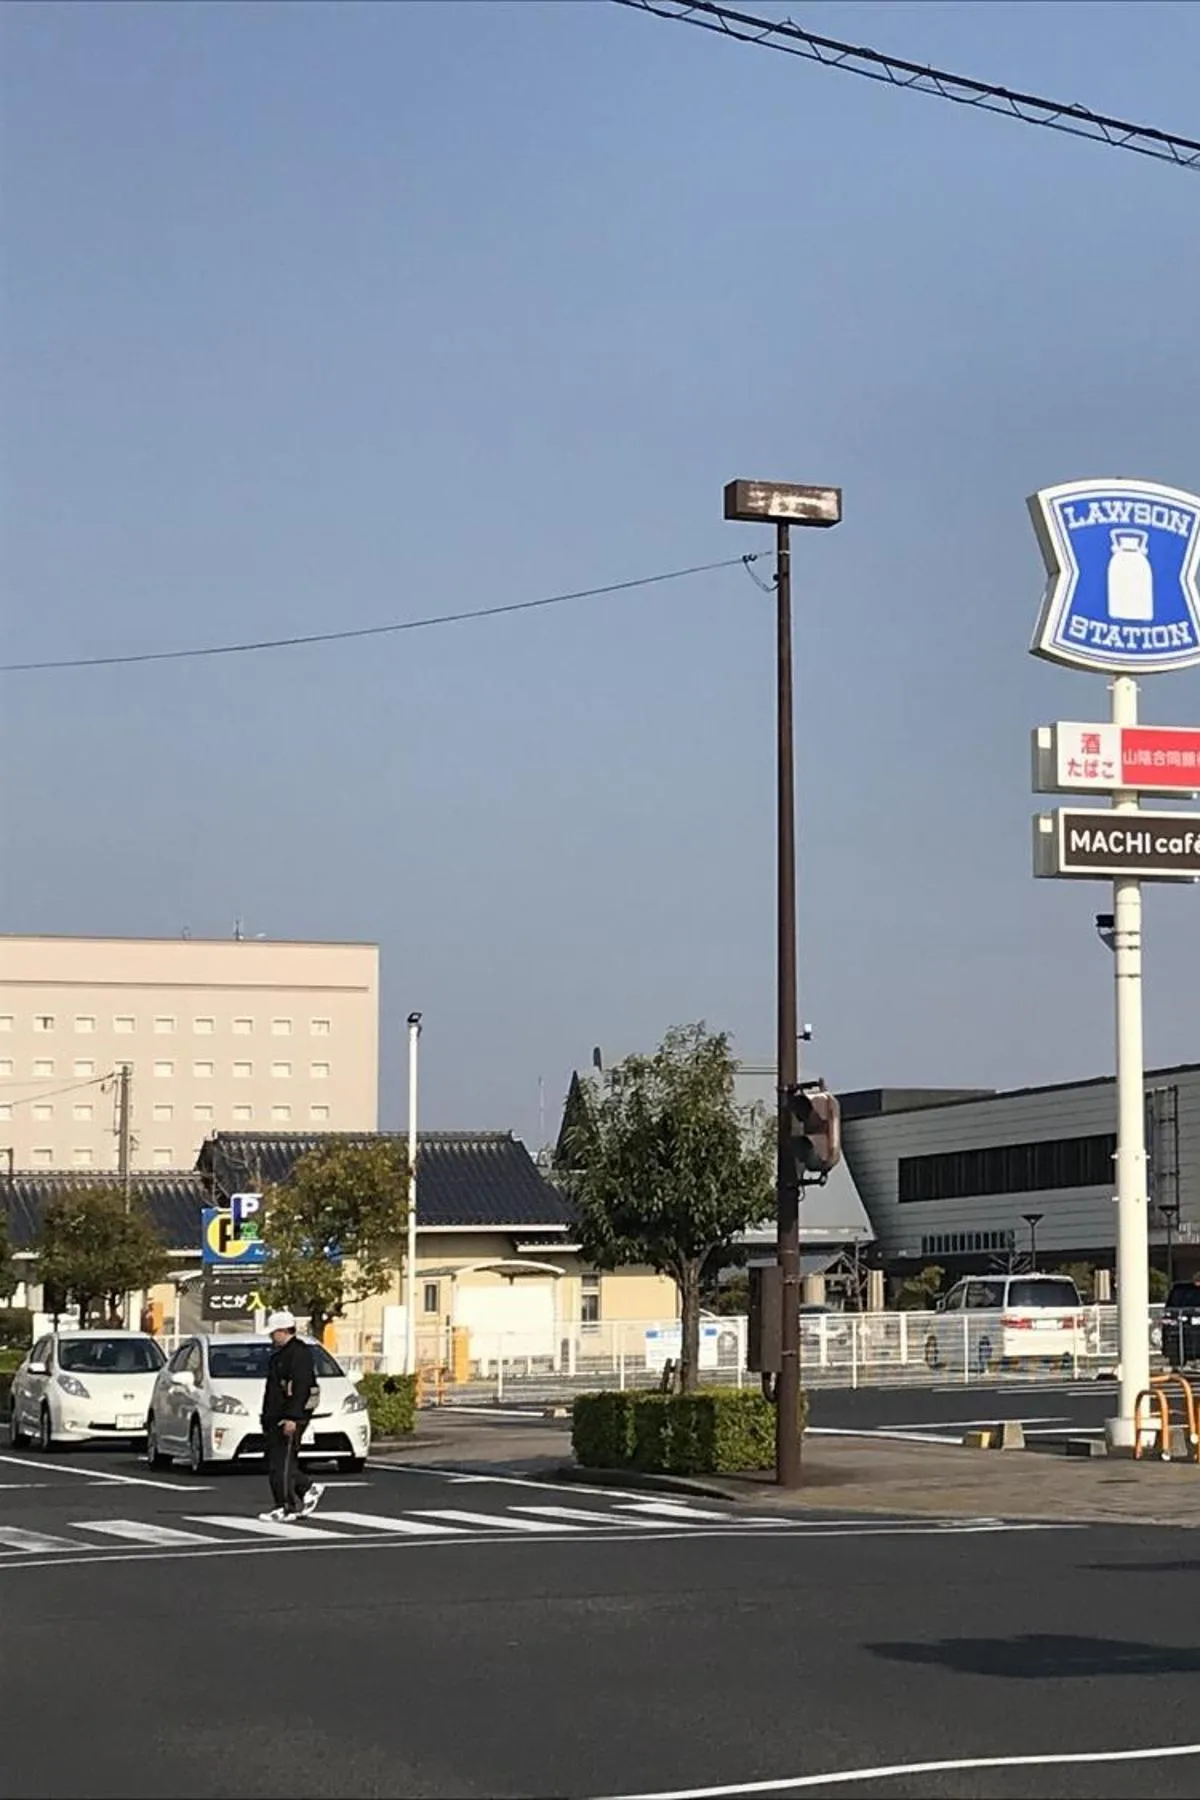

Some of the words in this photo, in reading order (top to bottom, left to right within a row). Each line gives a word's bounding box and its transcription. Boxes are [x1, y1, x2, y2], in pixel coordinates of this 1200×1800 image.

[1064, 500, 1192, 537] LAWSON
[1068, 615, 1193, 649] STATION
[1082, 732, 1101, 755] 酒
[1067, 758, 1115, 779] たばこ
[1070, 830, 1150, 854] MACHI
[241, 1198, 259, 1218] P
